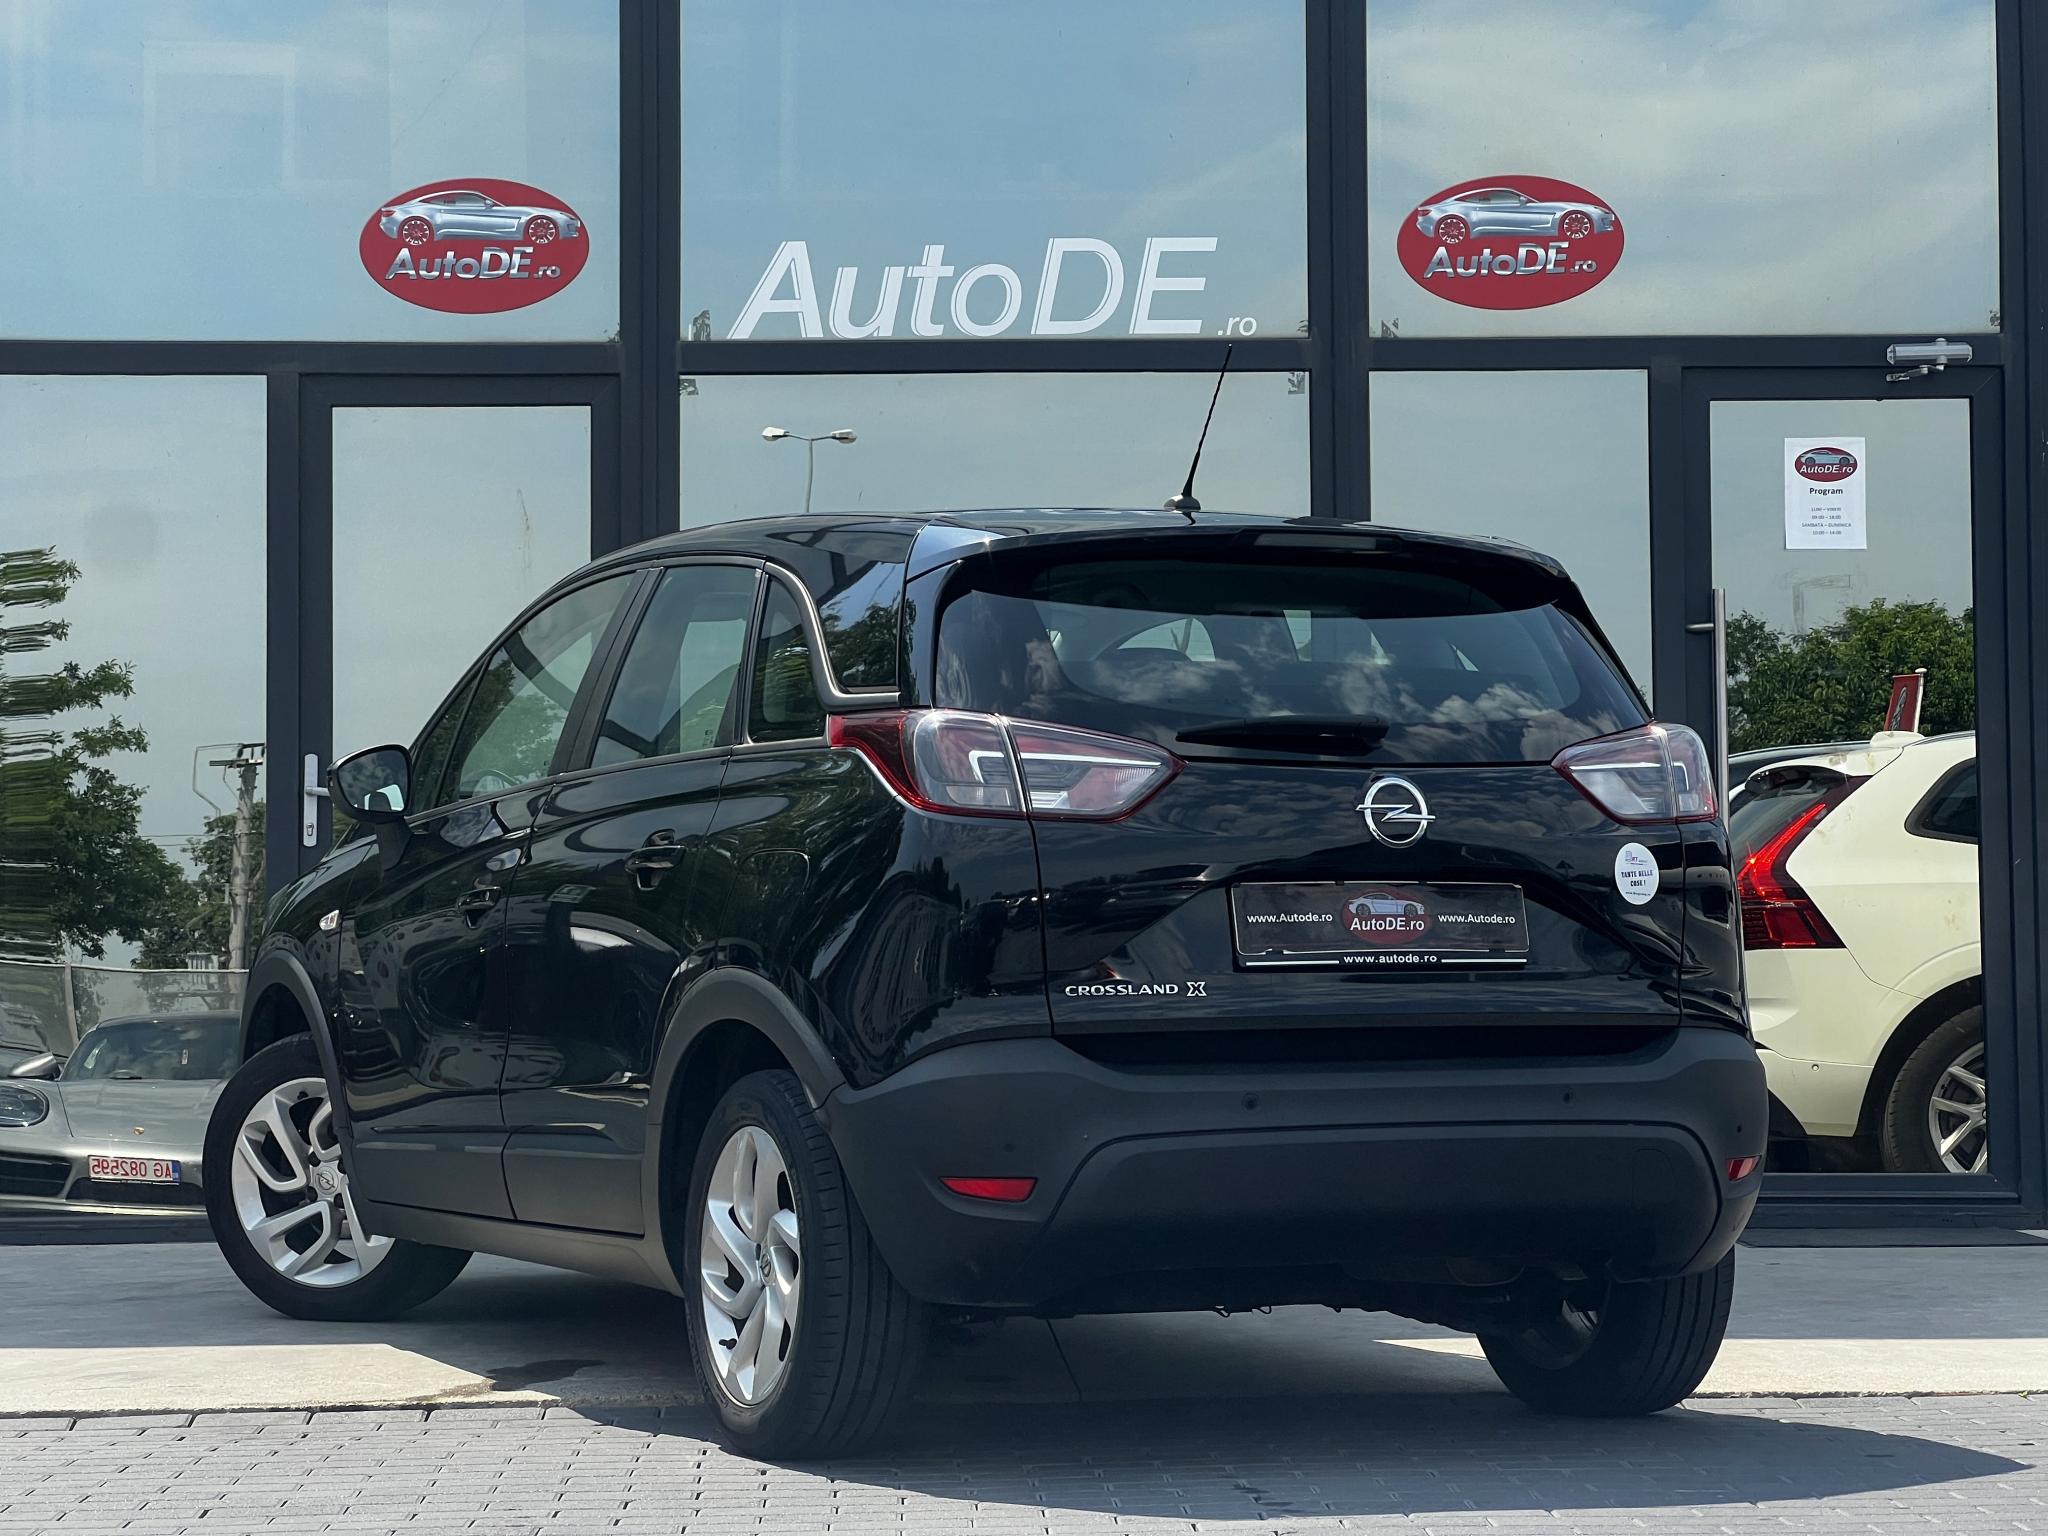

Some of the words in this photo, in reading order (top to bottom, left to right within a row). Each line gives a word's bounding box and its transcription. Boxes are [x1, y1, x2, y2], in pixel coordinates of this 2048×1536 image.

[726, 237, 1218, 339] AutoDE
[1810, 488, 1843, 496] Program
[1246, 912, 1333, 923] www.Autode.ro
[1438, 913, 1516, 924] www.Autode.ro
[1350, 917, 1425, 932] AutoDE.ro
[1343, 954, 1438, 964] www.autode.ro
[1065, 983, 1179, 997] CROSSLAND
[1186, 981, 1208, 997] X
